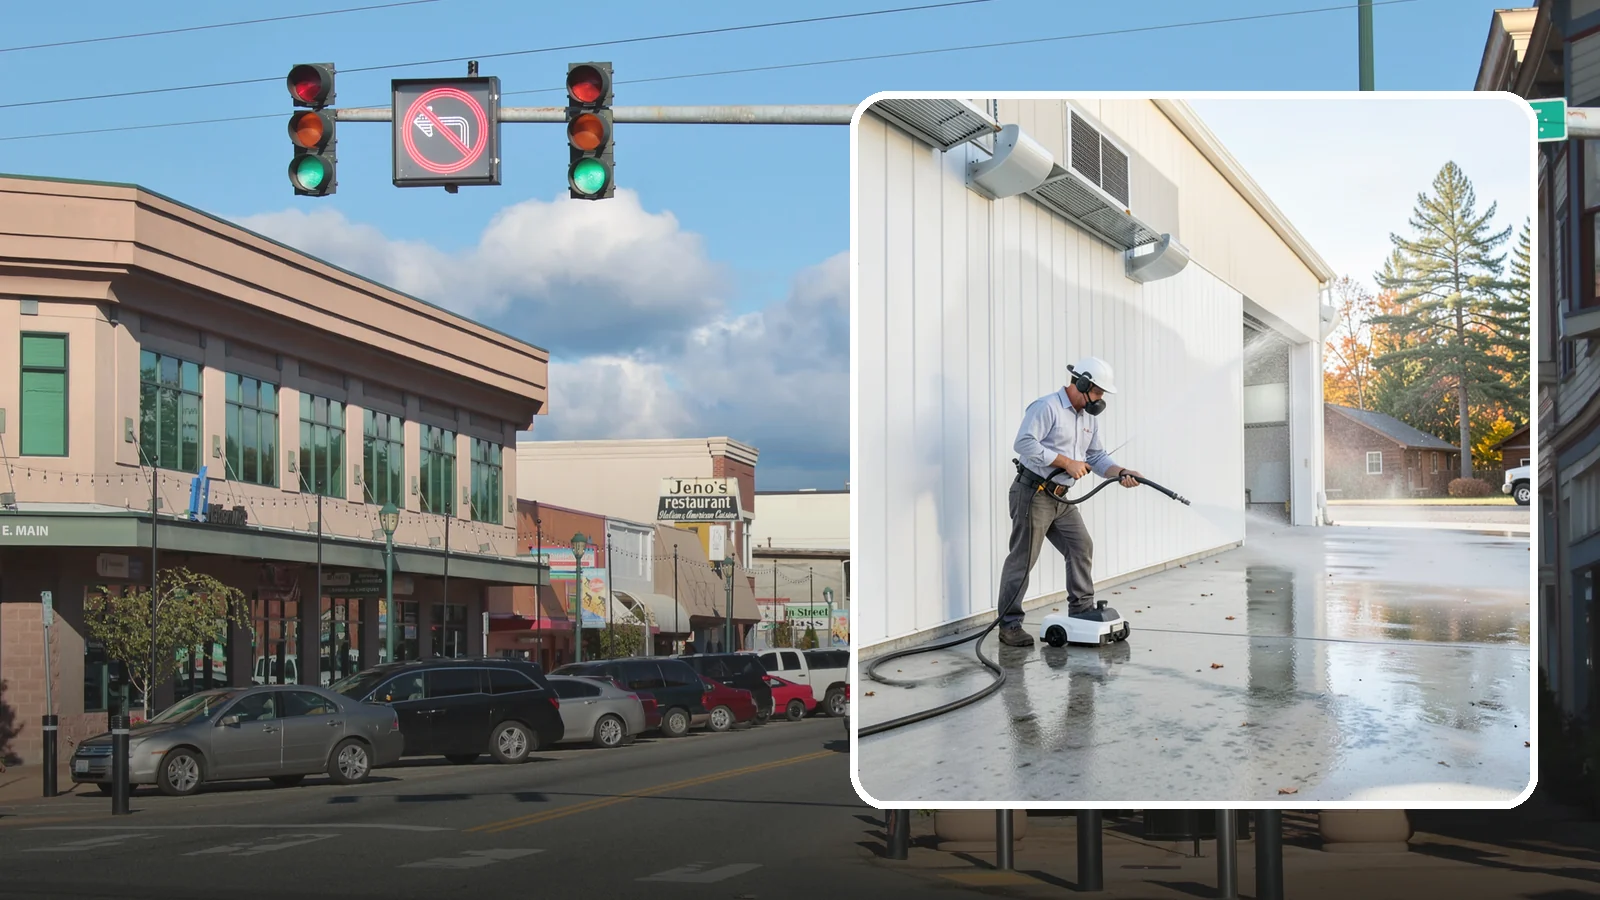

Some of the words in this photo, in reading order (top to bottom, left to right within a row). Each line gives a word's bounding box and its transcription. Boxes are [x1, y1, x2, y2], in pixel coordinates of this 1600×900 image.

[670, 480, 728, 494] Jeno's
[665, 496, 731, 509] restaurant
[658, 509, 682, 519] Italian
[685, 509, 715, 519] American
[715, 509, 738, 519] Cuisine
[2, 525, 13, 536] E.
[15, 525, 49, 536] MAIN
[797, 607, 828, 617] Street
